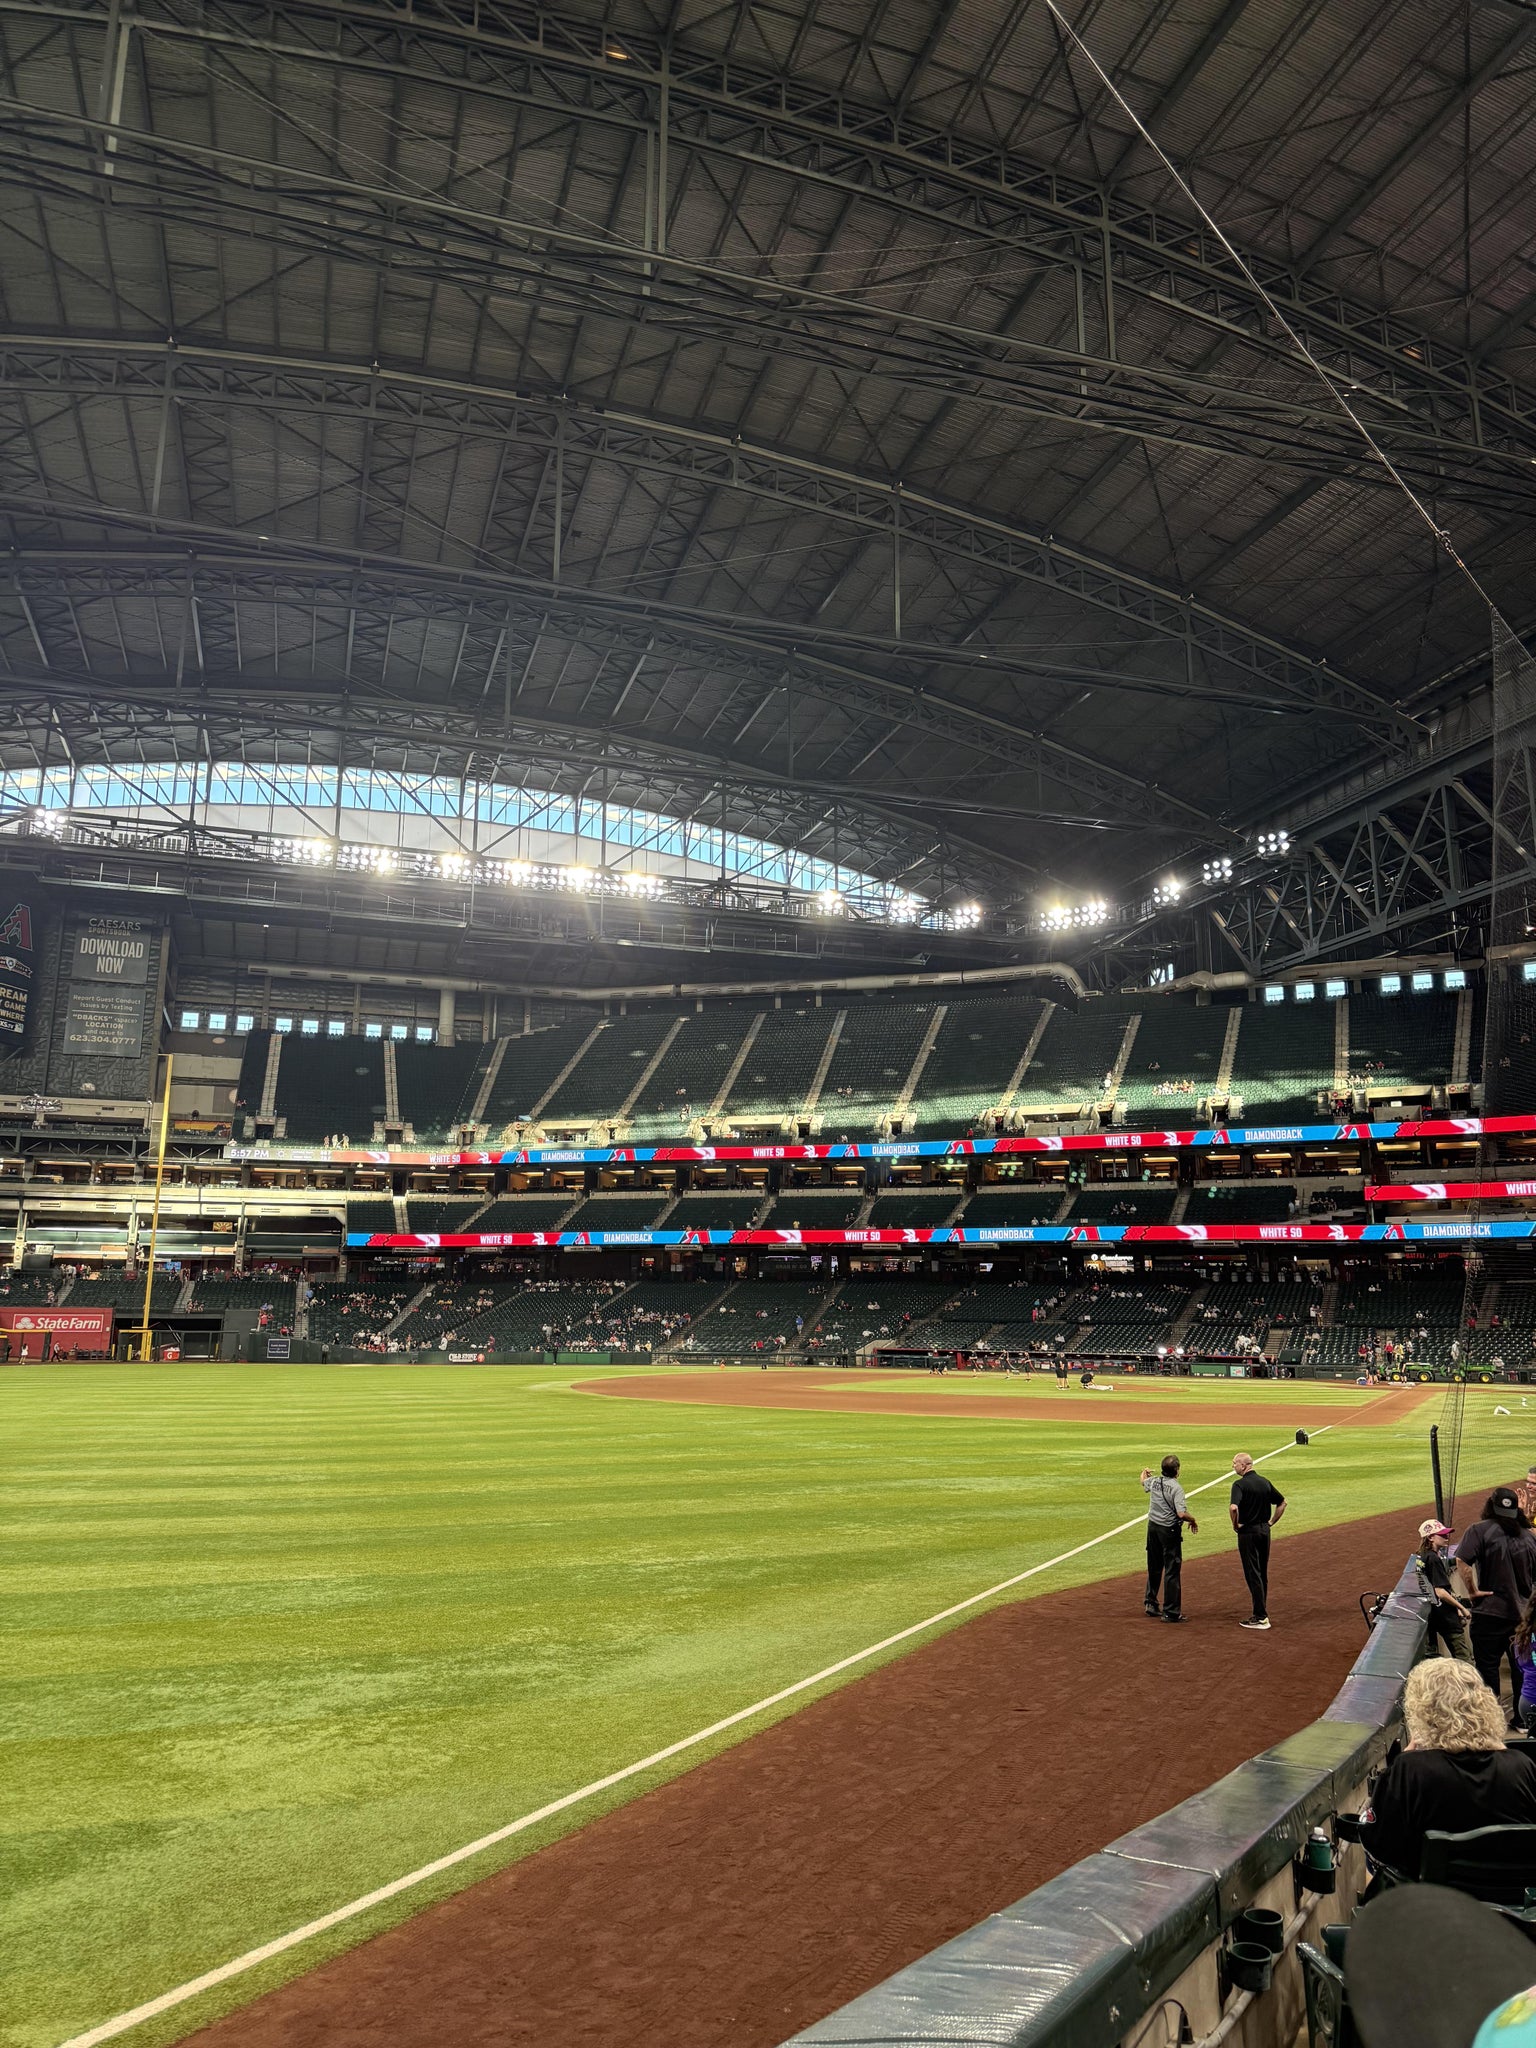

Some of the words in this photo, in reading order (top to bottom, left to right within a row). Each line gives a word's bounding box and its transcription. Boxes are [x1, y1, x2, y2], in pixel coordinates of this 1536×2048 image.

[88, 917, 141, 931] CAESARS
[80, 937, 144, 958] DOWNLOAD
[96, 956, 124, 974] NOW
[115, 997, 141, 1005] Conduct
[4, 1000, 26, 1013] GAME
[111, 1004, 133, 1012] Texting
[85, 1021, 124, 1029] LOCATION
[69, 1034, 136, 1045] 623.304.0777
[1245, 1129, 1303, 1140] DIAMONDBACK
[1105, 1136, 1129, 1146] WHITE
[230, 1149, 251, 1157] 5:57
[254, 1150, 269, 1158] PM
[541, 1151, 585, 1161] DIAMONDBACK
[753, 1148, 774, 1157] WHITE
[429, 1154, 450, 1163] WHITE
[1506, 1183, 1536, 1195] WHITE
[844, 1231, 868, 1241] WHITE
[979, 1229, 1034, 1240] DIAMONDBACK
[1259, 1227, 1287, 1238] WHITE
[1423, 1225, 1491, 1237] DIAMONDBACK
[480, 1235, 501, 1244] WHITE
[603, 1233, 653, 1243] DIAMONDBACK
